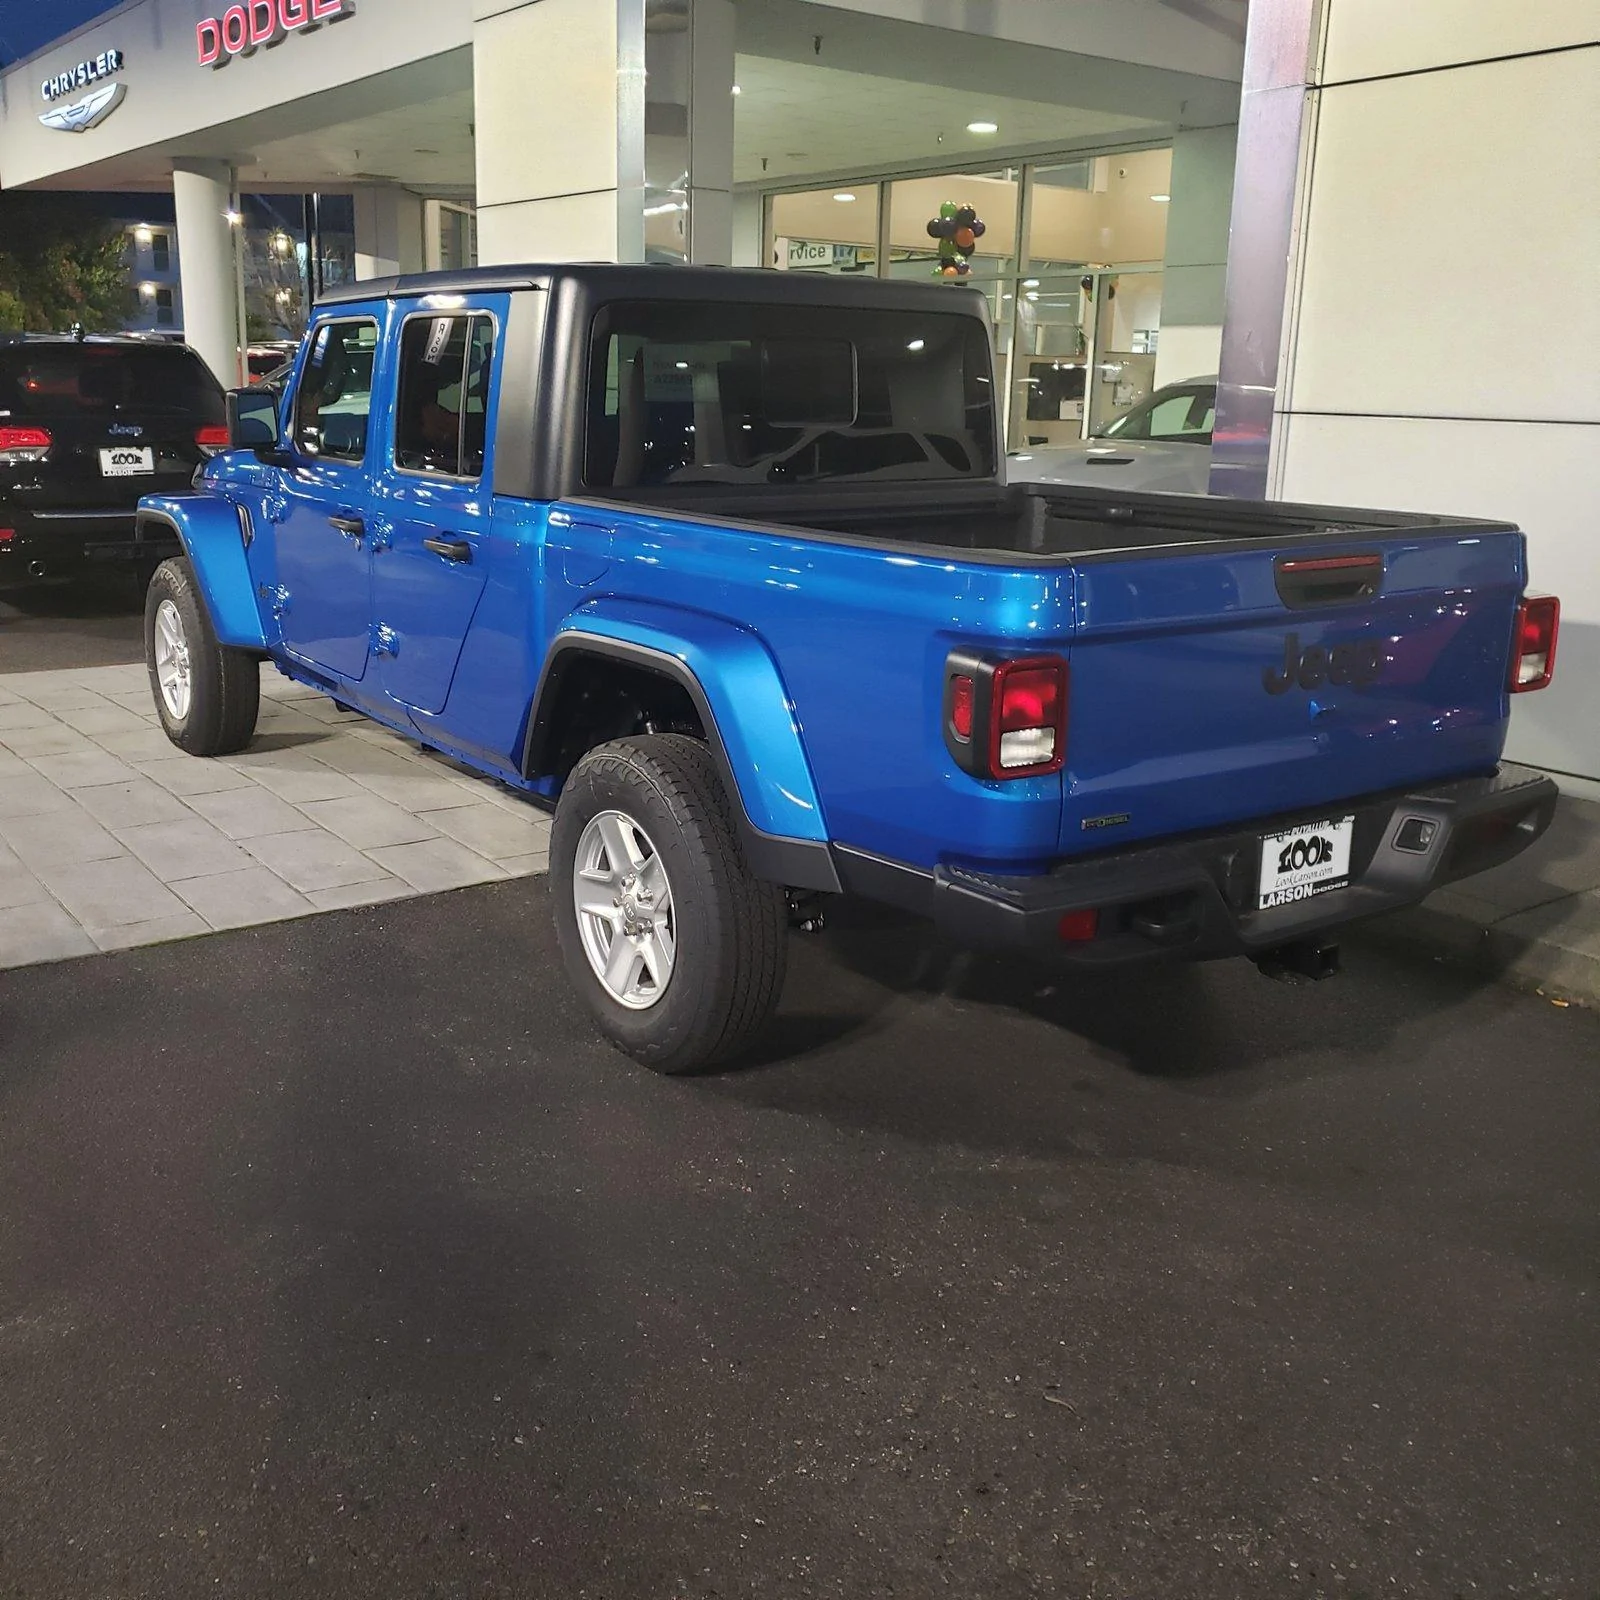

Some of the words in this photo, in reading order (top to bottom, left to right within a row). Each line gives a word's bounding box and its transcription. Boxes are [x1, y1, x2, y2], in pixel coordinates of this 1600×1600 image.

[41, 49, 119, 101] CHRYSLER
[108, 423, 143, 436] Jeep
[111, 453, 143, 465] LOOK
[1262, 632, 1382, 695] Jeep
[1277, 835, 1334, 874] LOOK
[1259, 883, 1314, 910] LARSON
[1313, 881, 1349, 895] DODGE
